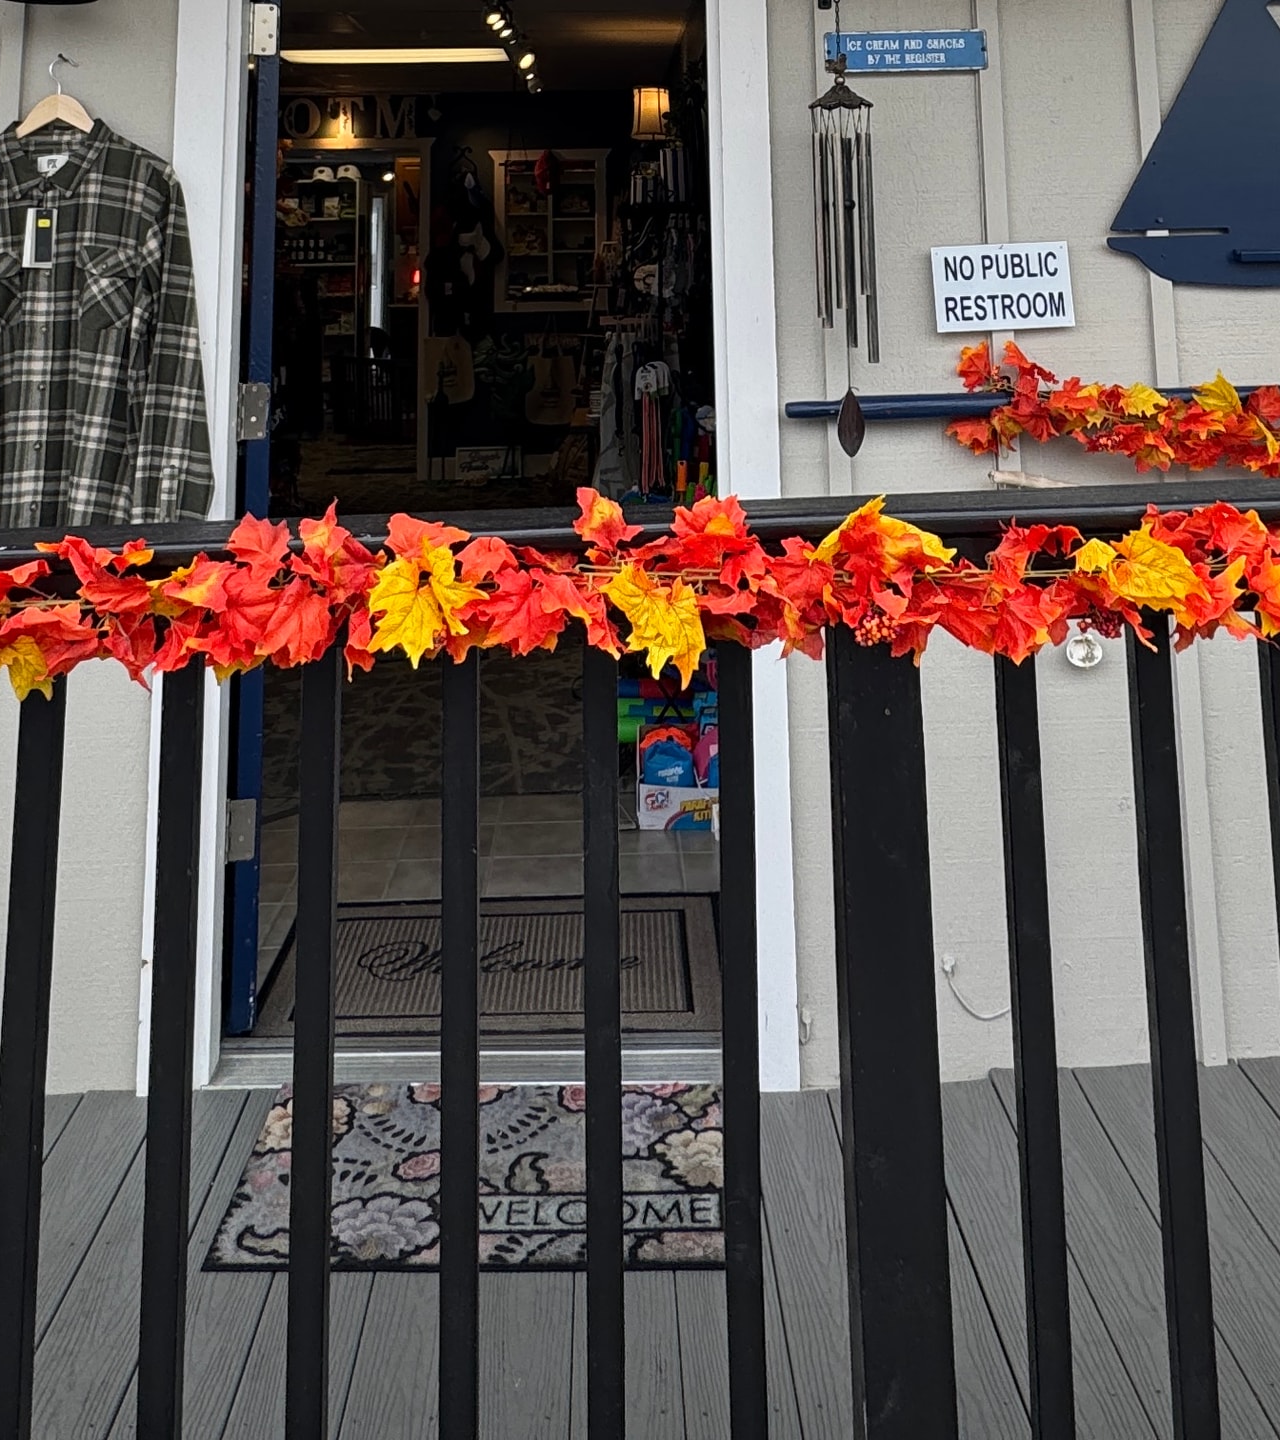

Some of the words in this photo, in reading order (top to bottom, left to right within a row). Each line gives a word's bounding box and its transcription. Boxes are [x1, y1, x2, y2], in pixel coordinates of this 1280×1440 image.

[865, 39, 899, 50] CREAM
[903, 38, 923, 50] AND
[867, 54, 880, 65] BY
[884, 54, 901, 64] THE
[905, 53, 946, 64] REGISTER
[944, 255, 974, 282] NO
[980, 251, 1058, 280] PUBLIC
[944, 291, 1066, 323] RESTROOM
